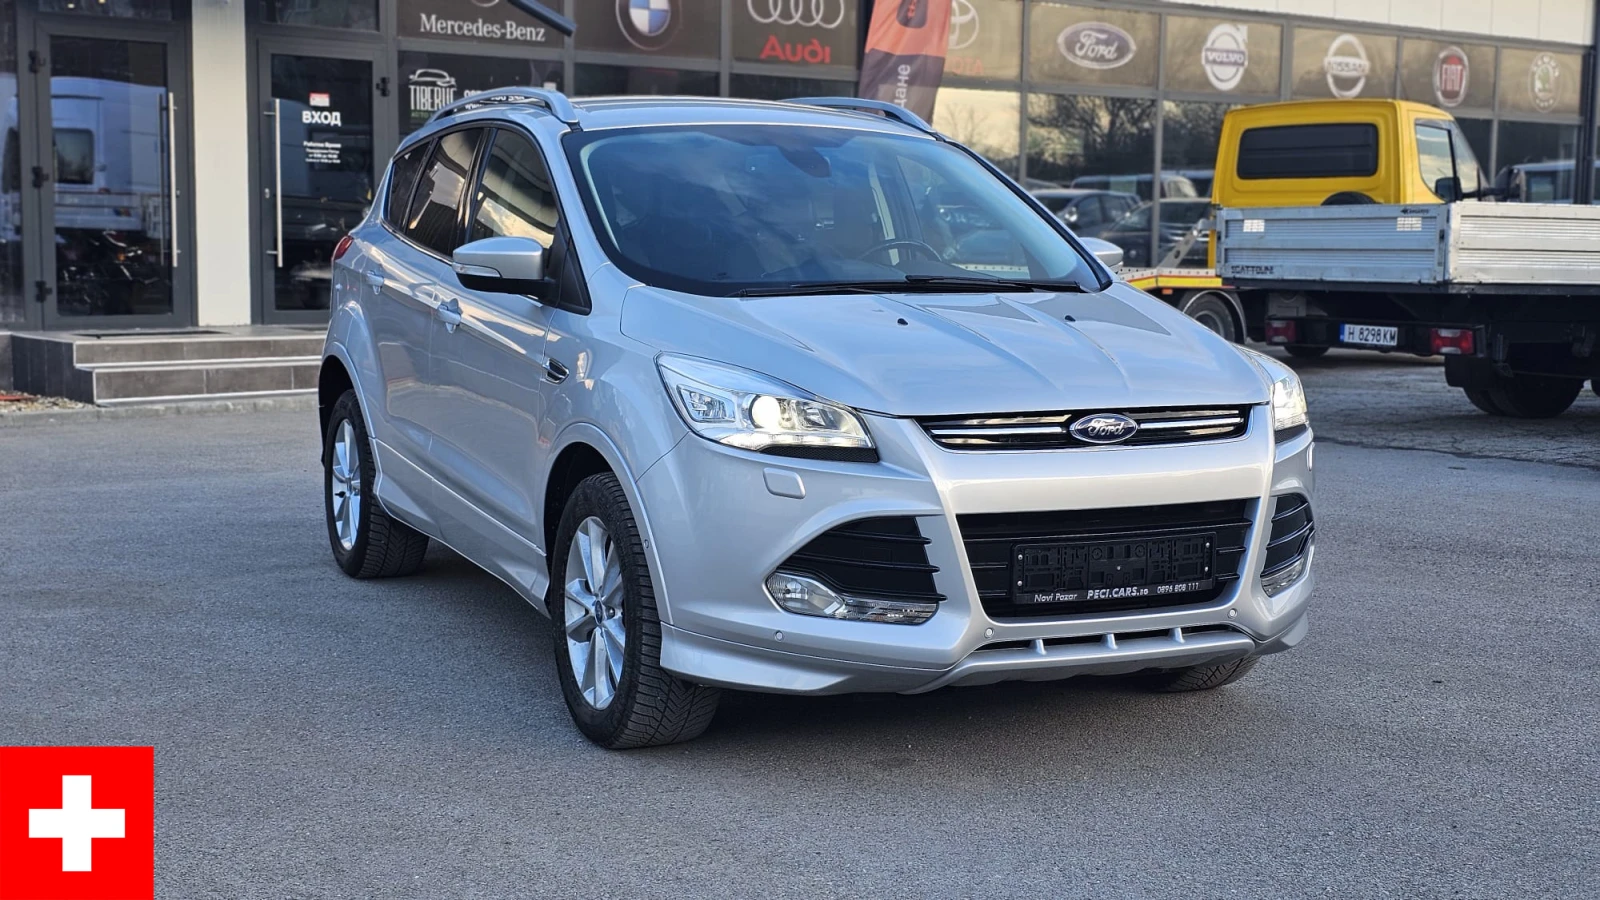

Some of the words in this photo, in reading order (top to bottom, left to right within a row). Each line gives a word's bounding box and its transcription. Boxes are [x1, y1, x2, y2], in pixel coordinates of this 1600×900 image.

[420, 13, 545, 42] Mercedes-Benz
[760, 35, 831, 64] Audi
[1075, 30, 1118, 60] Ford
[1206, 51, 1244, 63] VOLVO
[1442, 64, 1463, 90] FIAT
[302, 110, 342, 127] ВХОД
[1348, 326, 1355, 340] H
[1087, 418, 1125, 436] Ford
[1034, 592, 1054, 602] Novi
[1055, 592, 1077, 601] Pazar
